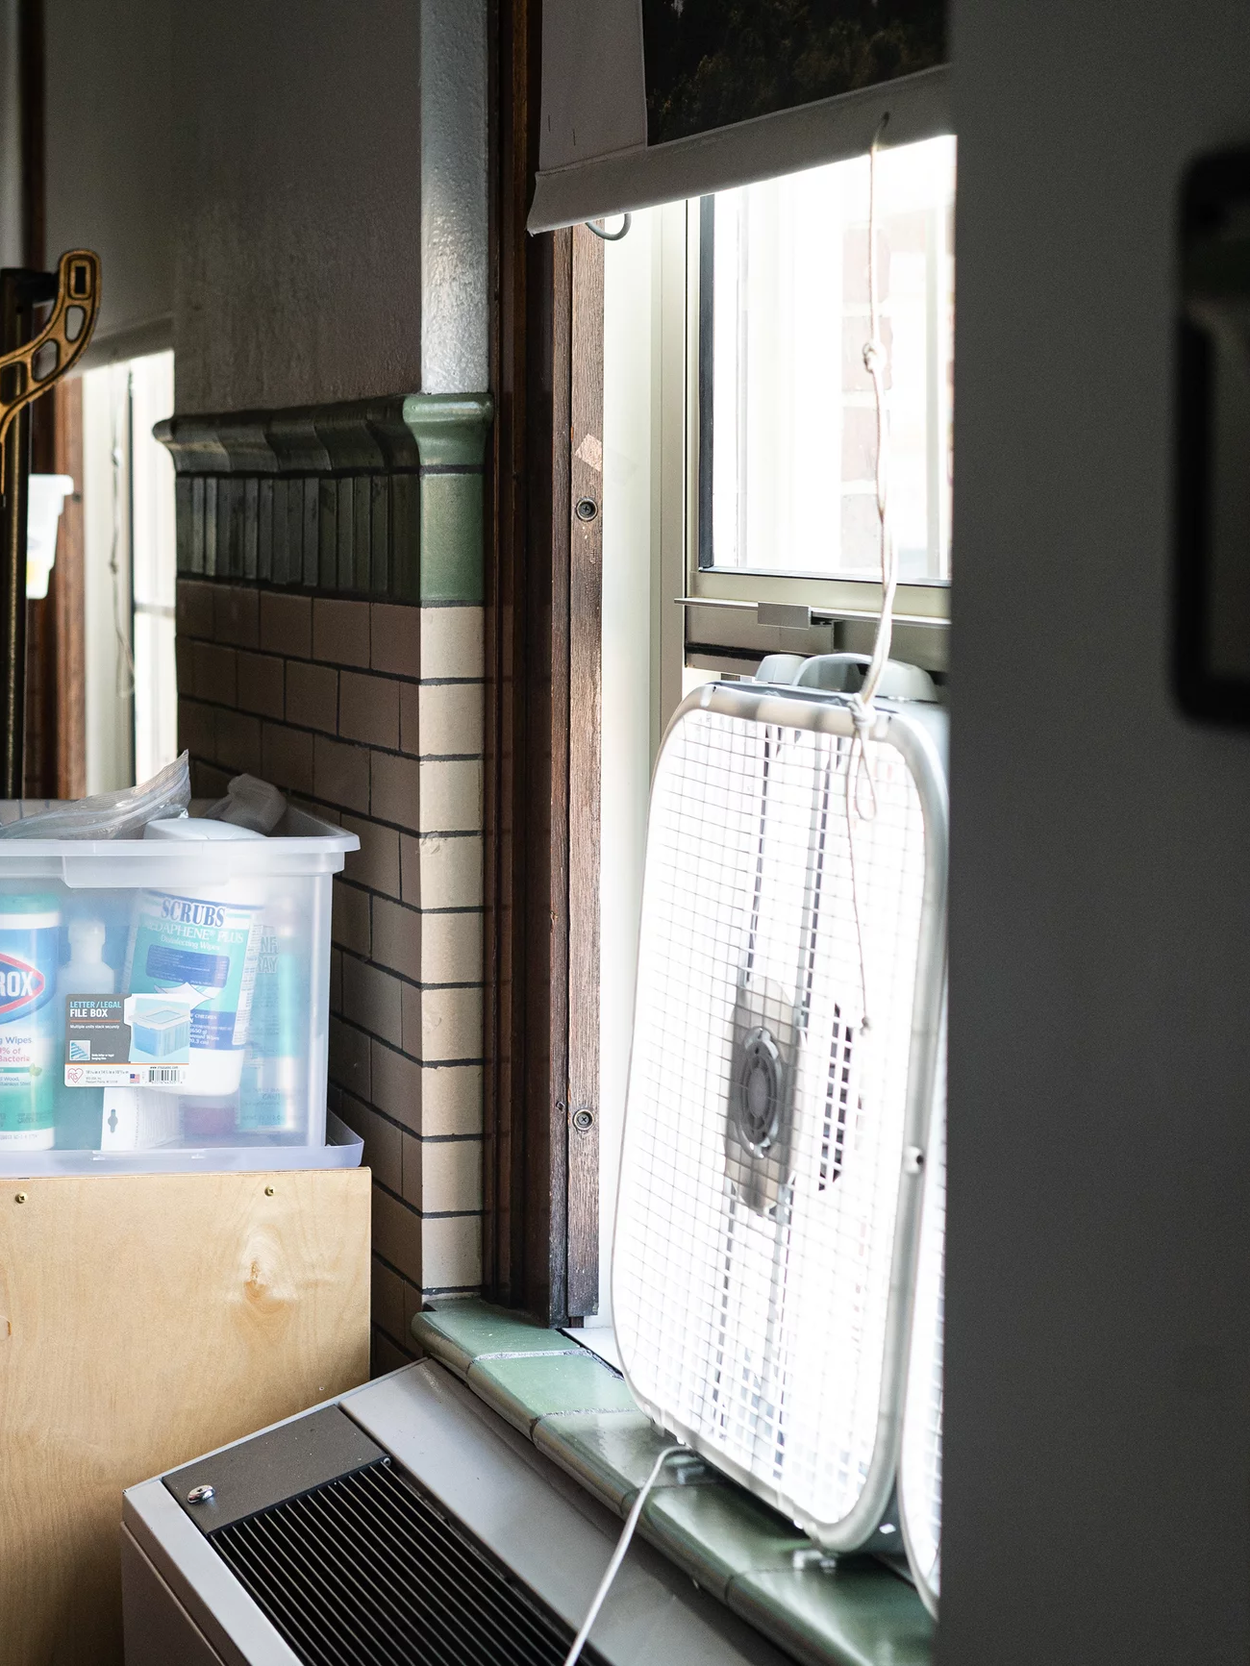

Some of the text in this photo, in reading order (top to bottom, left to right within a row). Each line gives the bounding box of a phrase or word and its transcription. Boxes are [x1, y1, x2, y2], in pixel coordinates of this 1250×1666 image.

[160, 898, 226, 928] SCRUBS
[217, 930, 245, 944] PLUS
[69, 1009, 108, 1018] FILE BOX
[5, 1036, 33, 1045] Wipes
